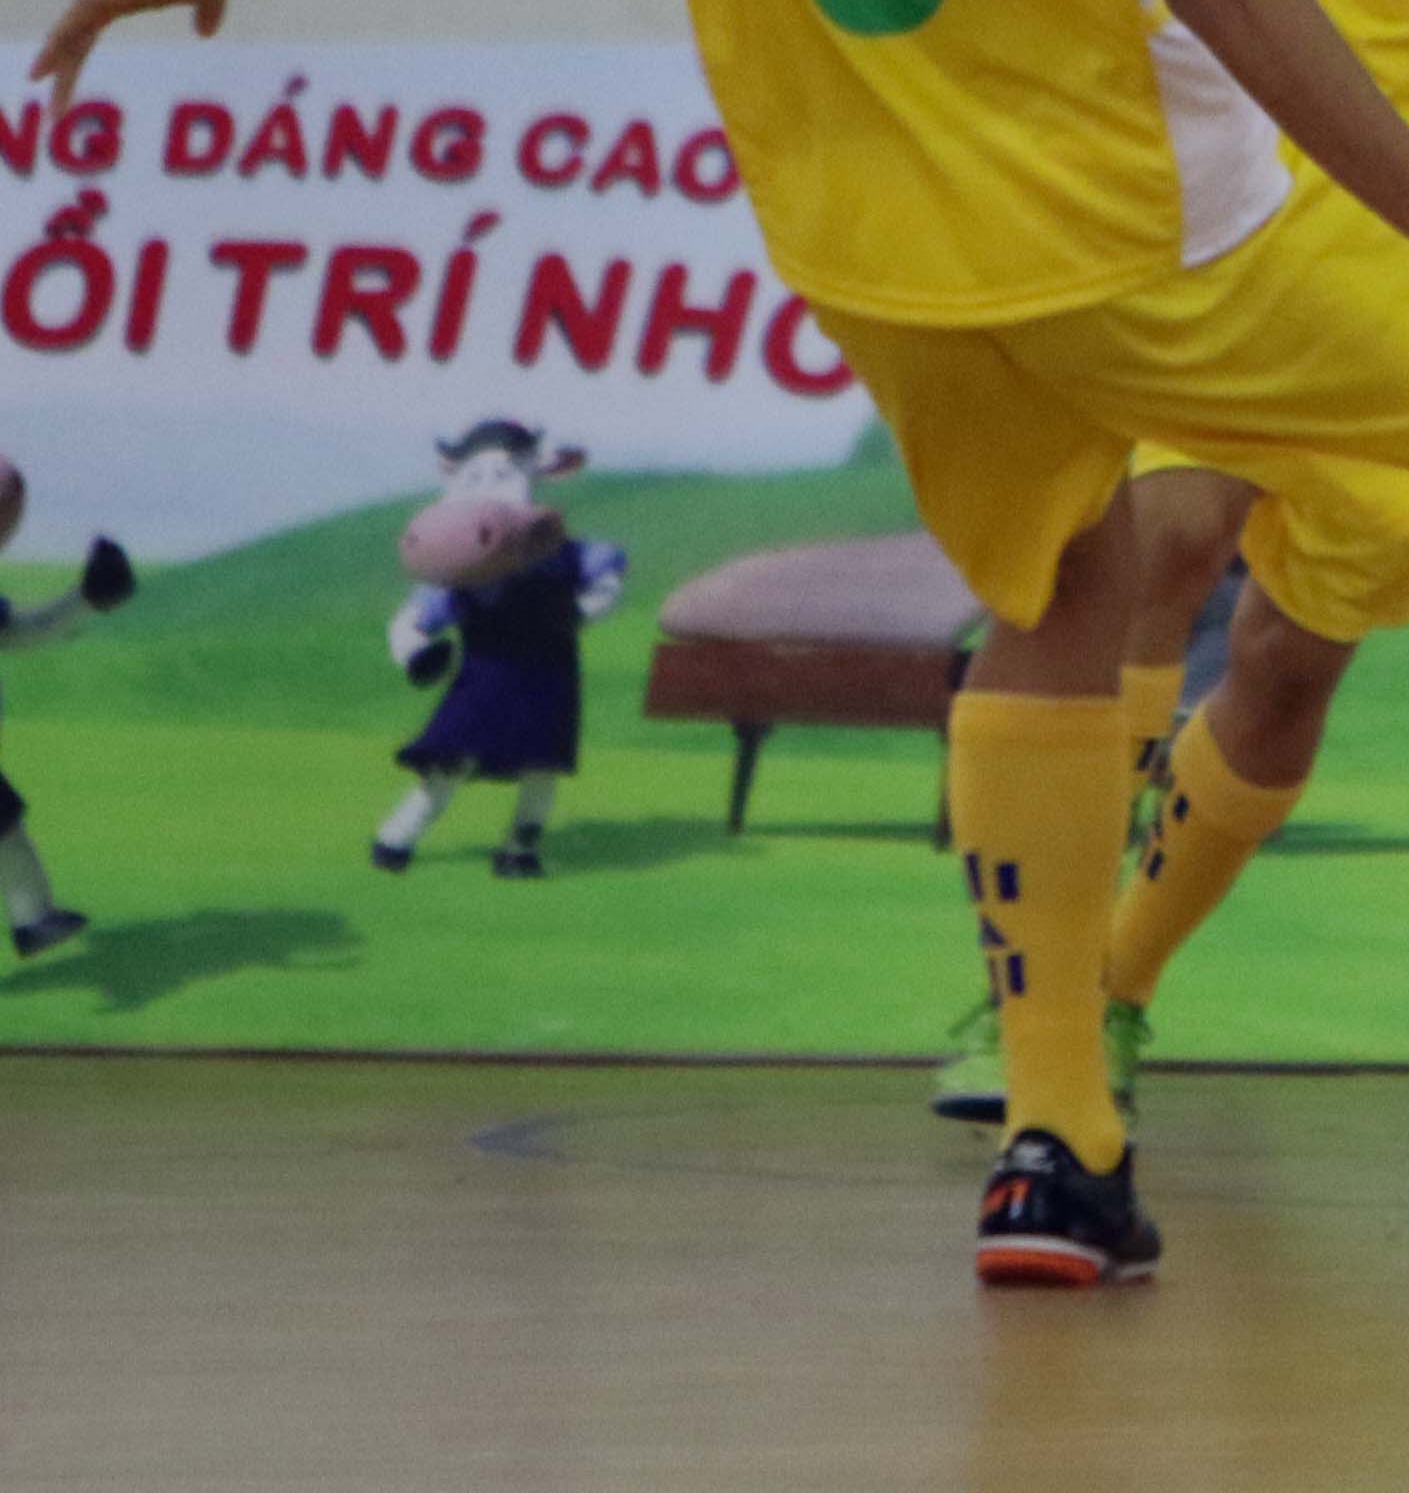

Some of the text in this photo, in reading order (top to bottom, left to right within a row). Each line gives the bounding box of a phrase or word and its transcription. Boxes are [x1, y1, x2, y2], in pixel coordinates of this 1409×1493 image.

[163, 74, 488, 184] DÁNG
[516, 113, 742, 205] CAO
[209, 209, 502, 362] TRÍ
